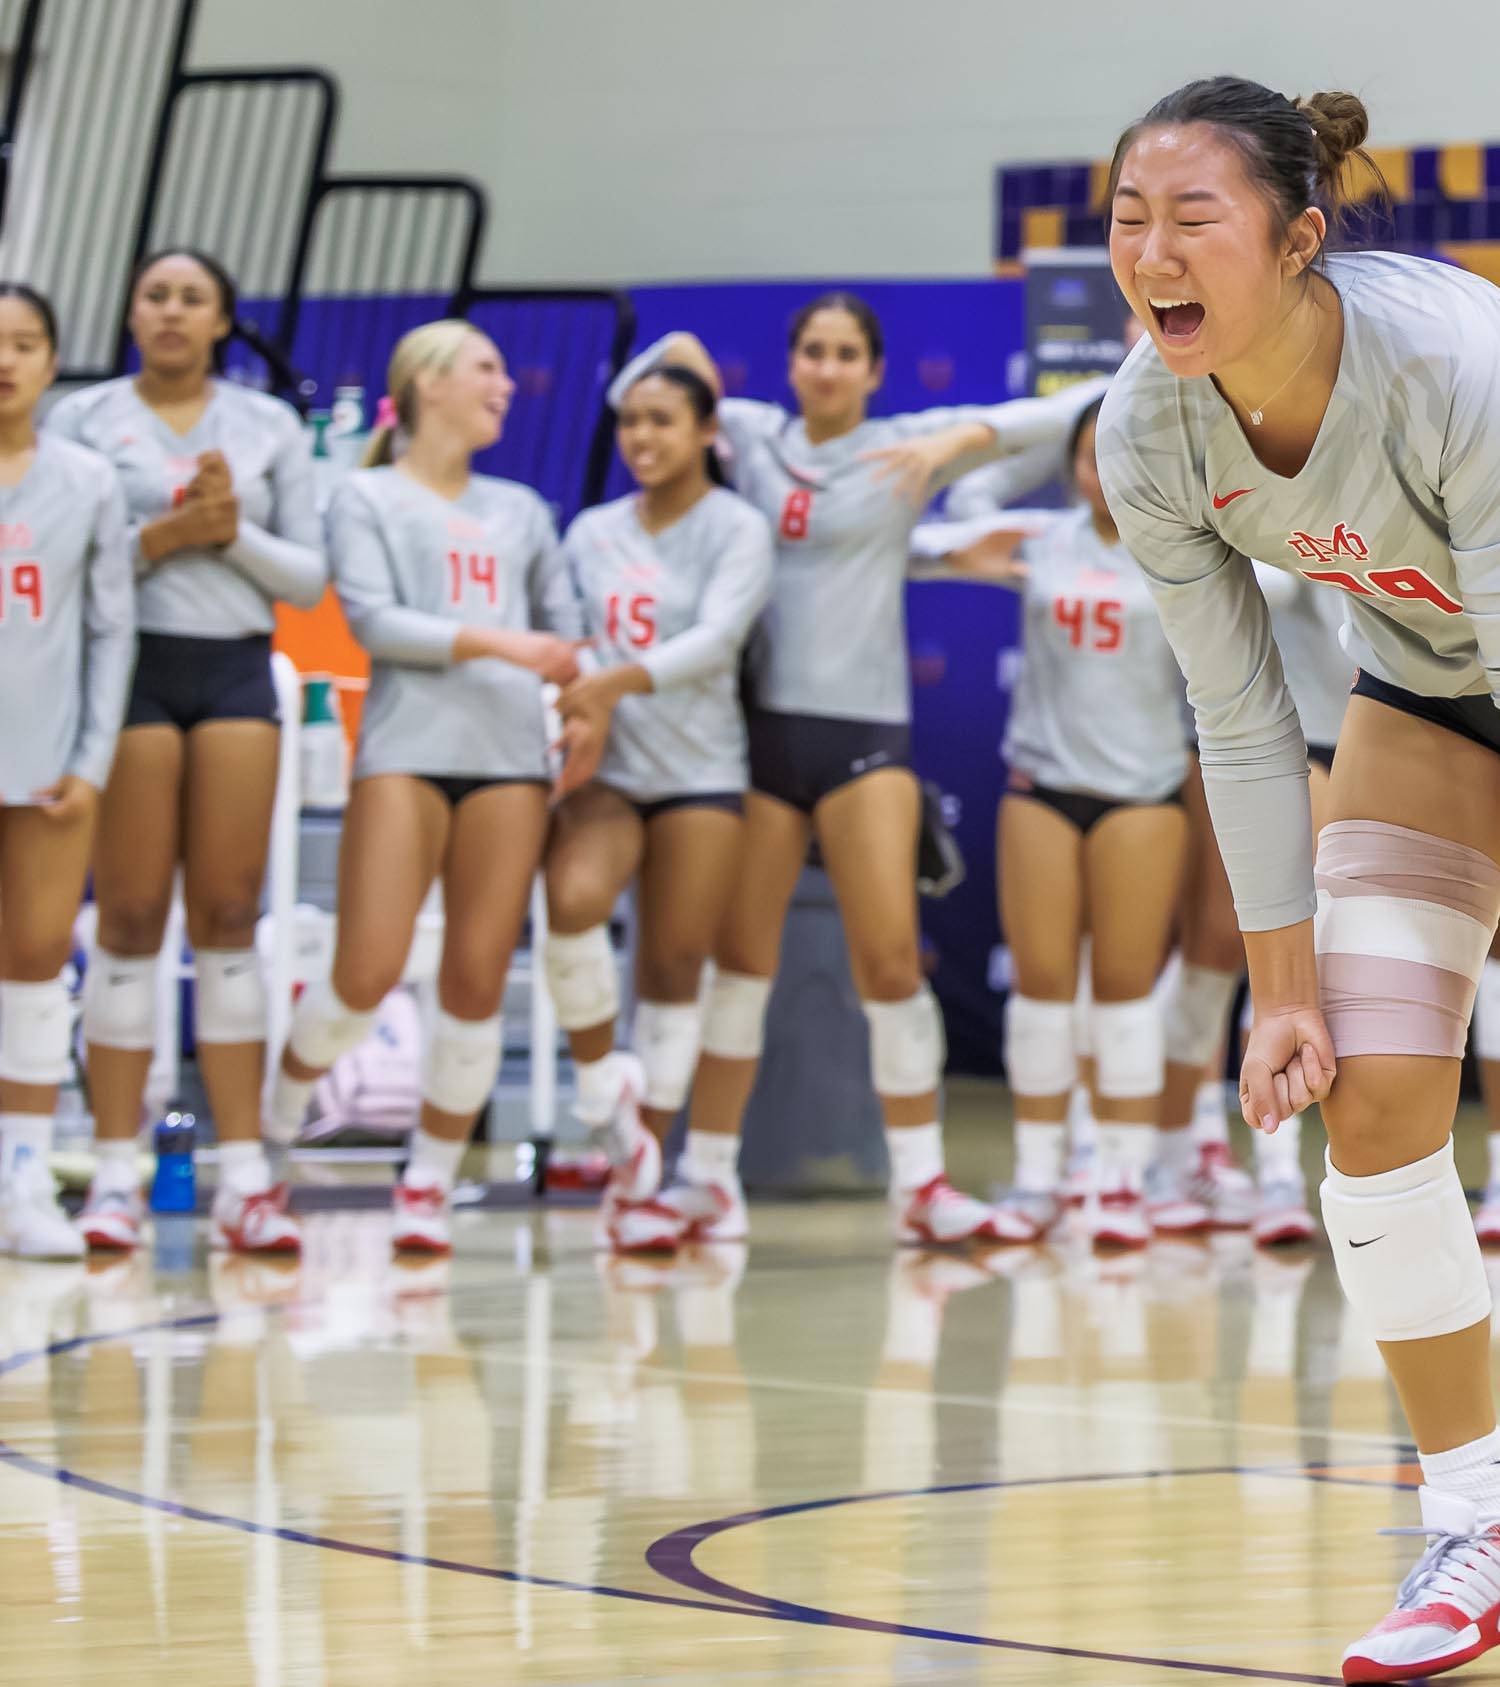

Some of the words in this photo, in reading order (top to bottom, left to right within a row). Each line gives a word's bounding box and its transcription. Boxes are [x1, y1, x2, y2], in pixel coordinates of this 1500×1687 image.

[779, 490, 813, 540] 8
[446, 550, 497, 605] 14
[1053, 596, 1124, 653] 45
